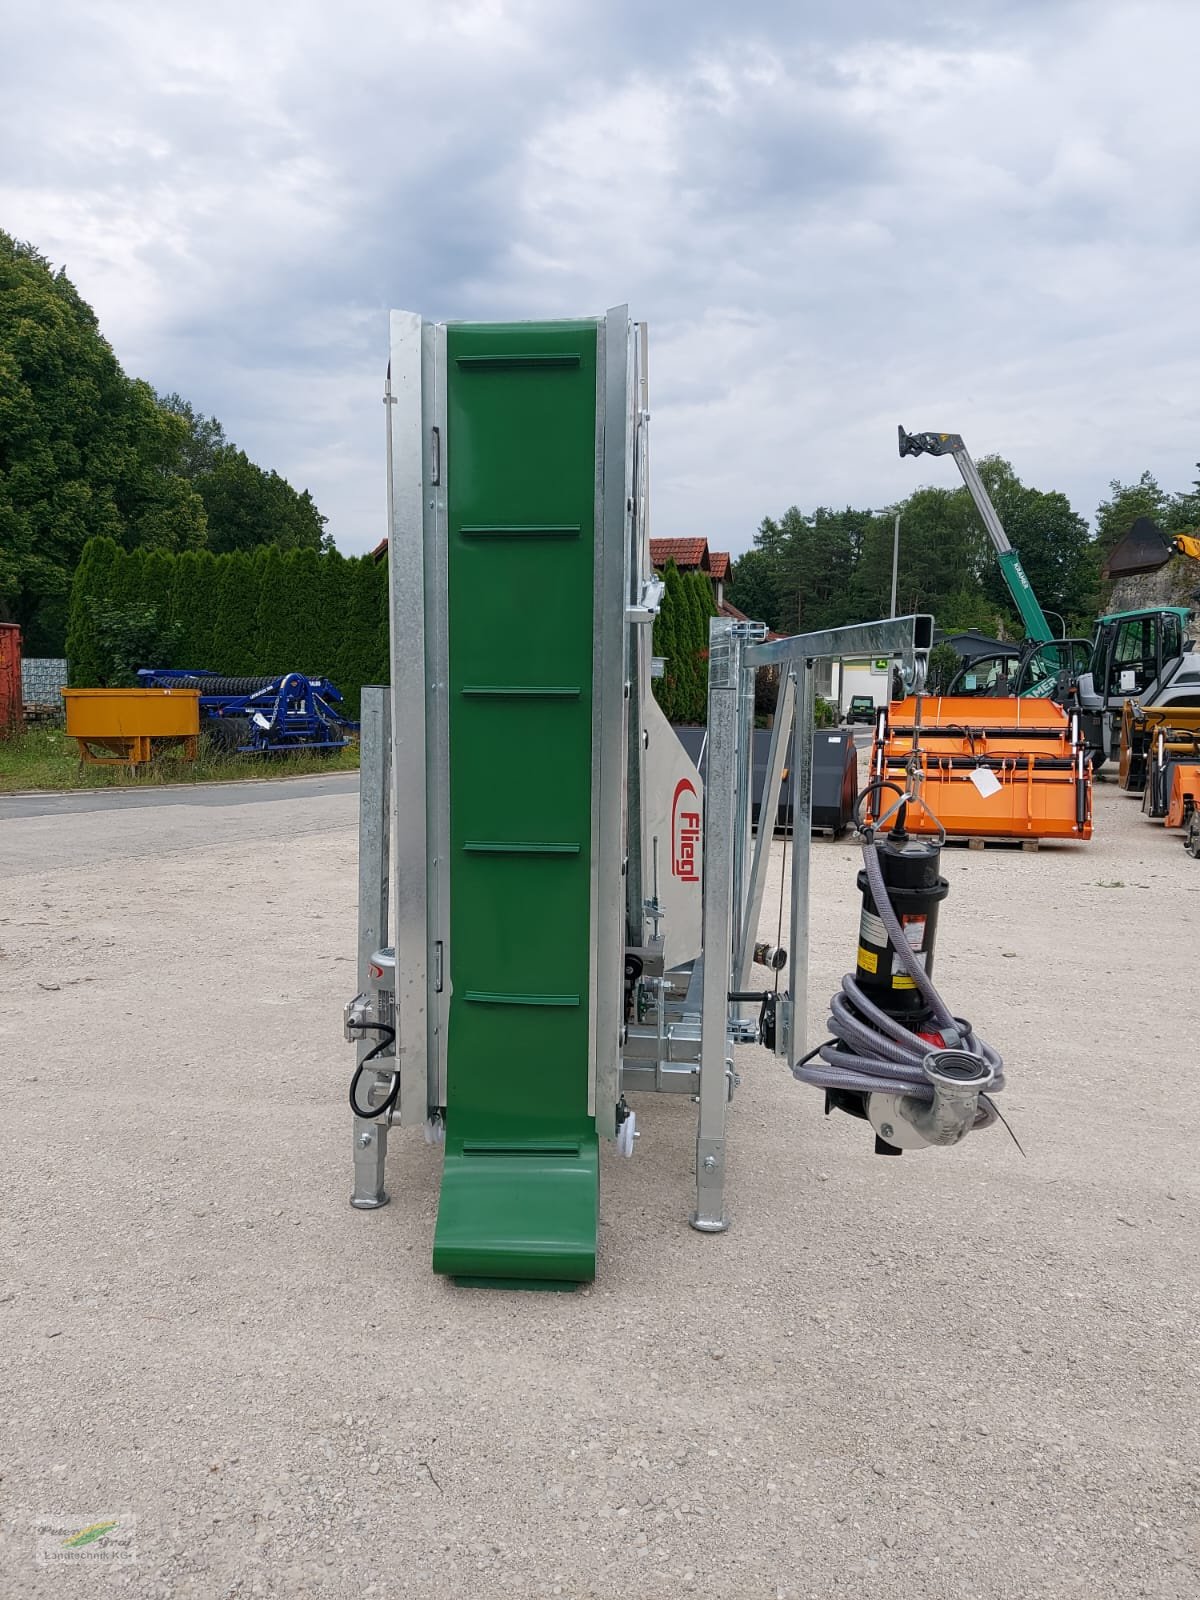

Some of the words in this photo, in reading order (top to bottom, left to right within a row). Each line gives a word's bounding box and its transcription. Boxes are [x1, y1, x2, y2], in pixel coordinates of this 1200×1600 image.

[1013, 562, 1029, 590] KRAMER
[1025, 677, 1058, 698] AMER
[676, 812, 699, 882] Fliegl
